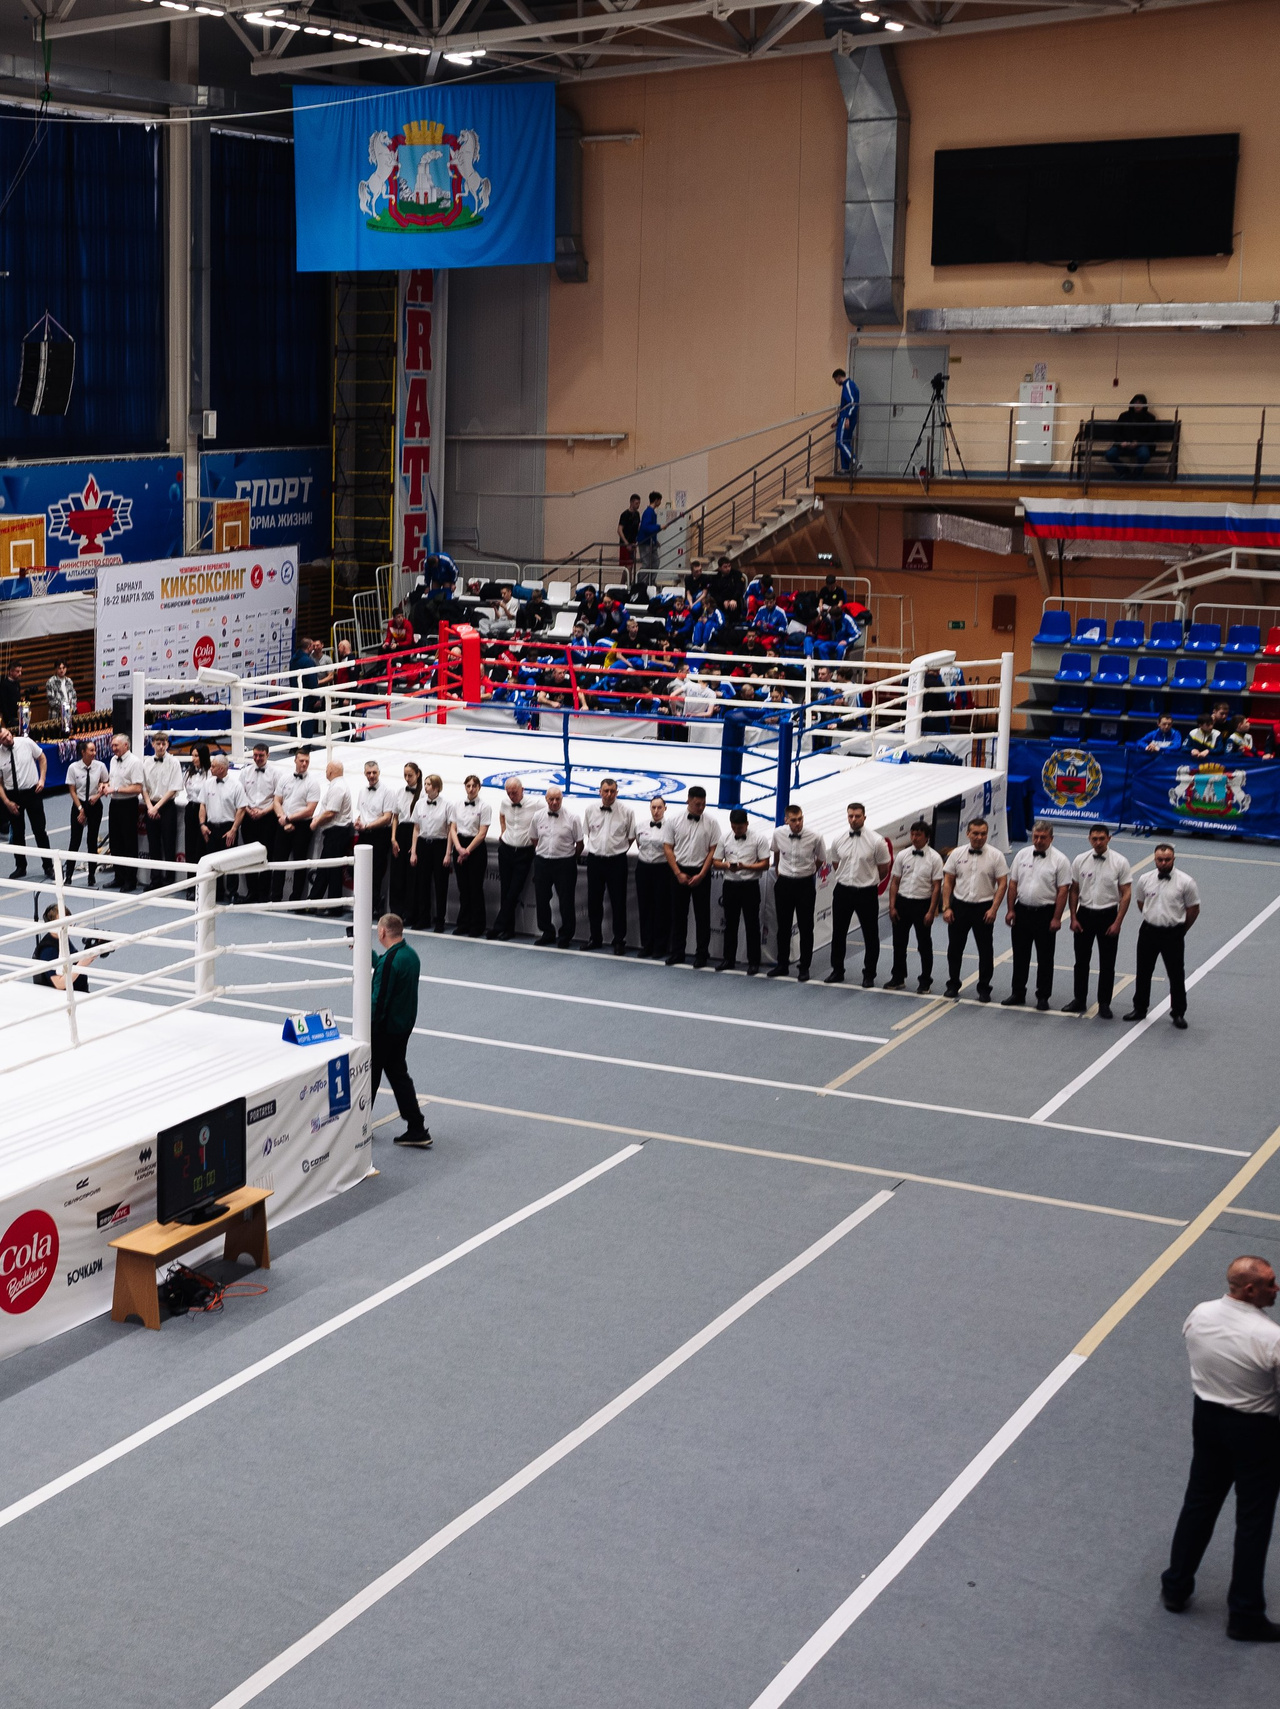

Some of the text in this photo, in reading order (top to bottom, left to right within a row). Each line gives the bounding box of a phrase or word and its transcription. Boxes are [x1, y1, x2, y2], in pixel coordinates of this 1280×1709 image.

[235, 477, 313, 508] СПОРТ
[277, 511, 313, 528] ЖИЗНИ!
[60, 556, 122, 571] МИНИСТЕРСТВО СПОРТА
[116, 580, 143, 592] БАРНАУЛ
[160, 567, 246, 600] КИКБОКСИНГ
[103, 590, 155, 607] 18-22 МАРТА 2026
[195, 644, 214, 657] Cola
[1039, 807, 1099, 819] АЛТАЙСКИЙ КРАЙ
[298, 1019, 305, 1033] 6
[325, 1013, 332, 1027] 6
[335, 1075, 344, 1100] 1
[67, 1258, 103, 1287] БОЧКАРИ
